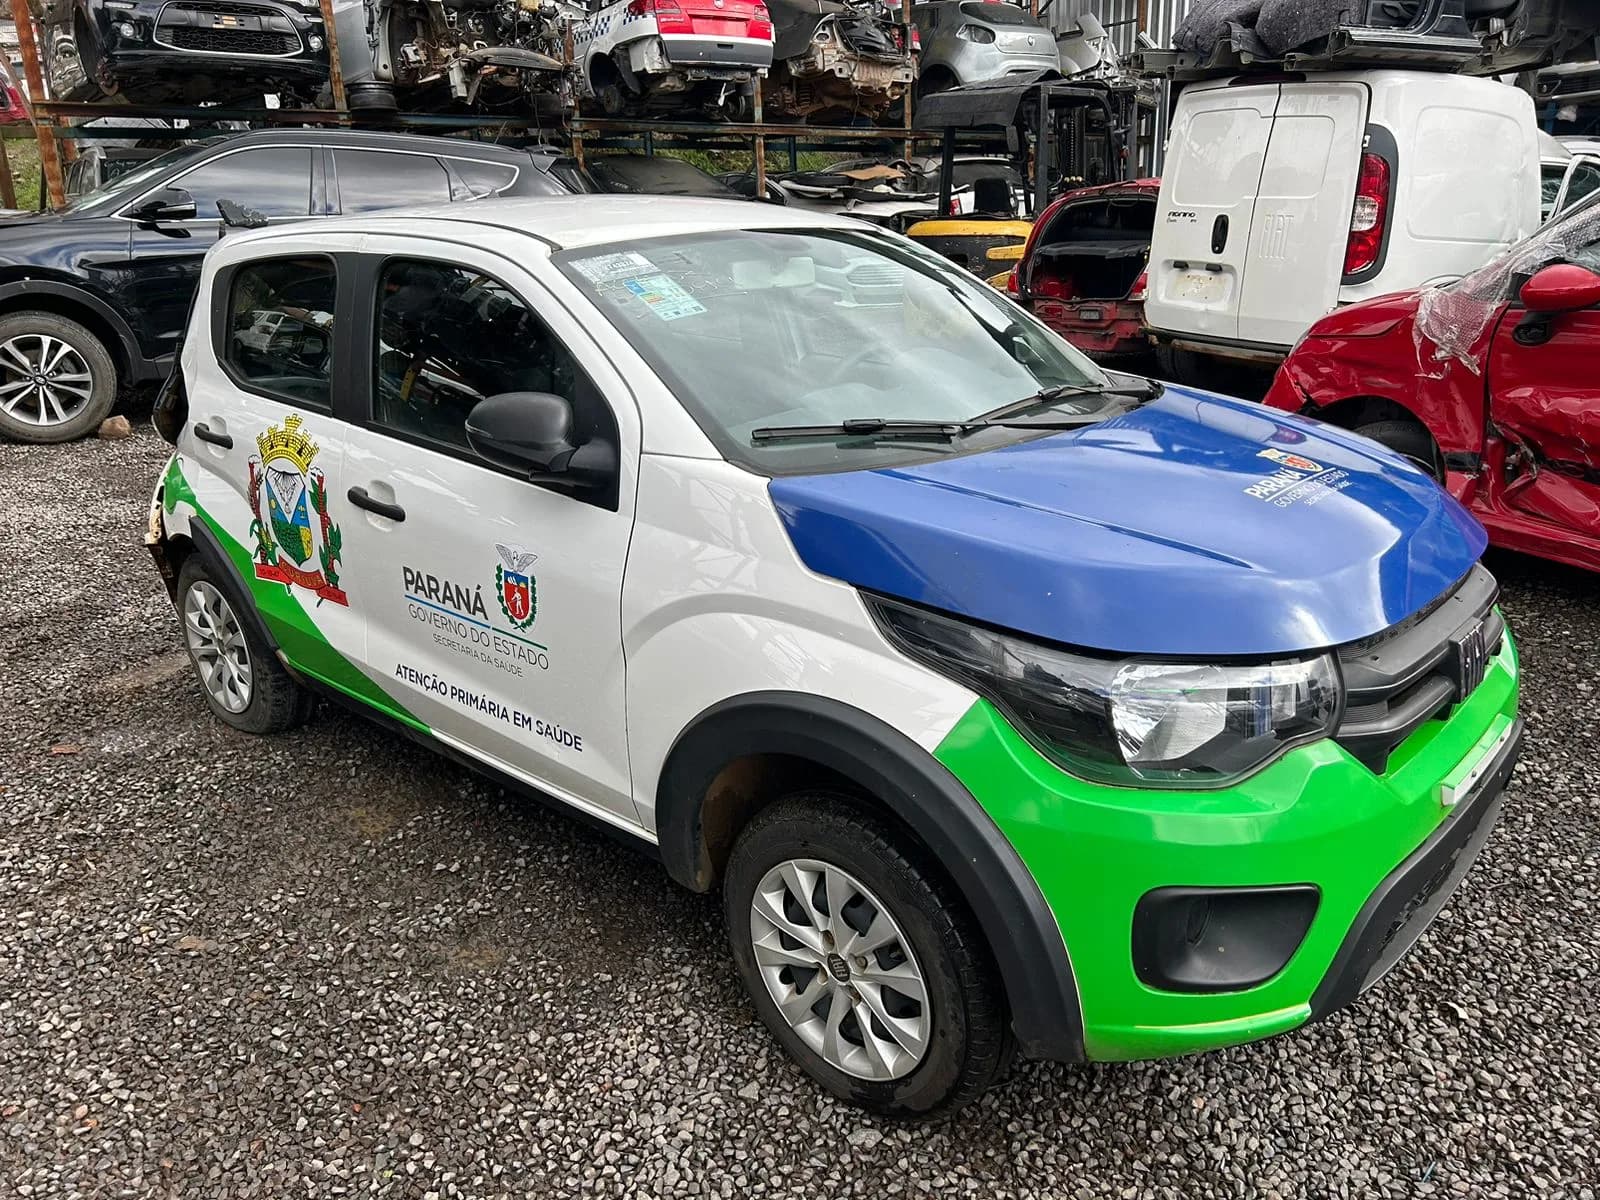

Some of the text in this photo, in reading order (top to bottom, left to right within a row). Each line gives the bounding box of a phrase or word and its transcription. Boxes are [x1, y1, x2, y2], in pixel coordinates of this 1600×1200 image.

[1243, 467, 1307, 499] PARANÁ
[402, 566, 489, 621] PARANÁ
[408, 603, 549, 670] GOVERNO DO ESTADO
[432, 633, 524, 678] SECRETARIA DA SAÚDE
[395, 663, 583, 752] ATENÇÃO PRIMÁRIA EM SAÚDE
[830, 957, 848, 977] FIAT
